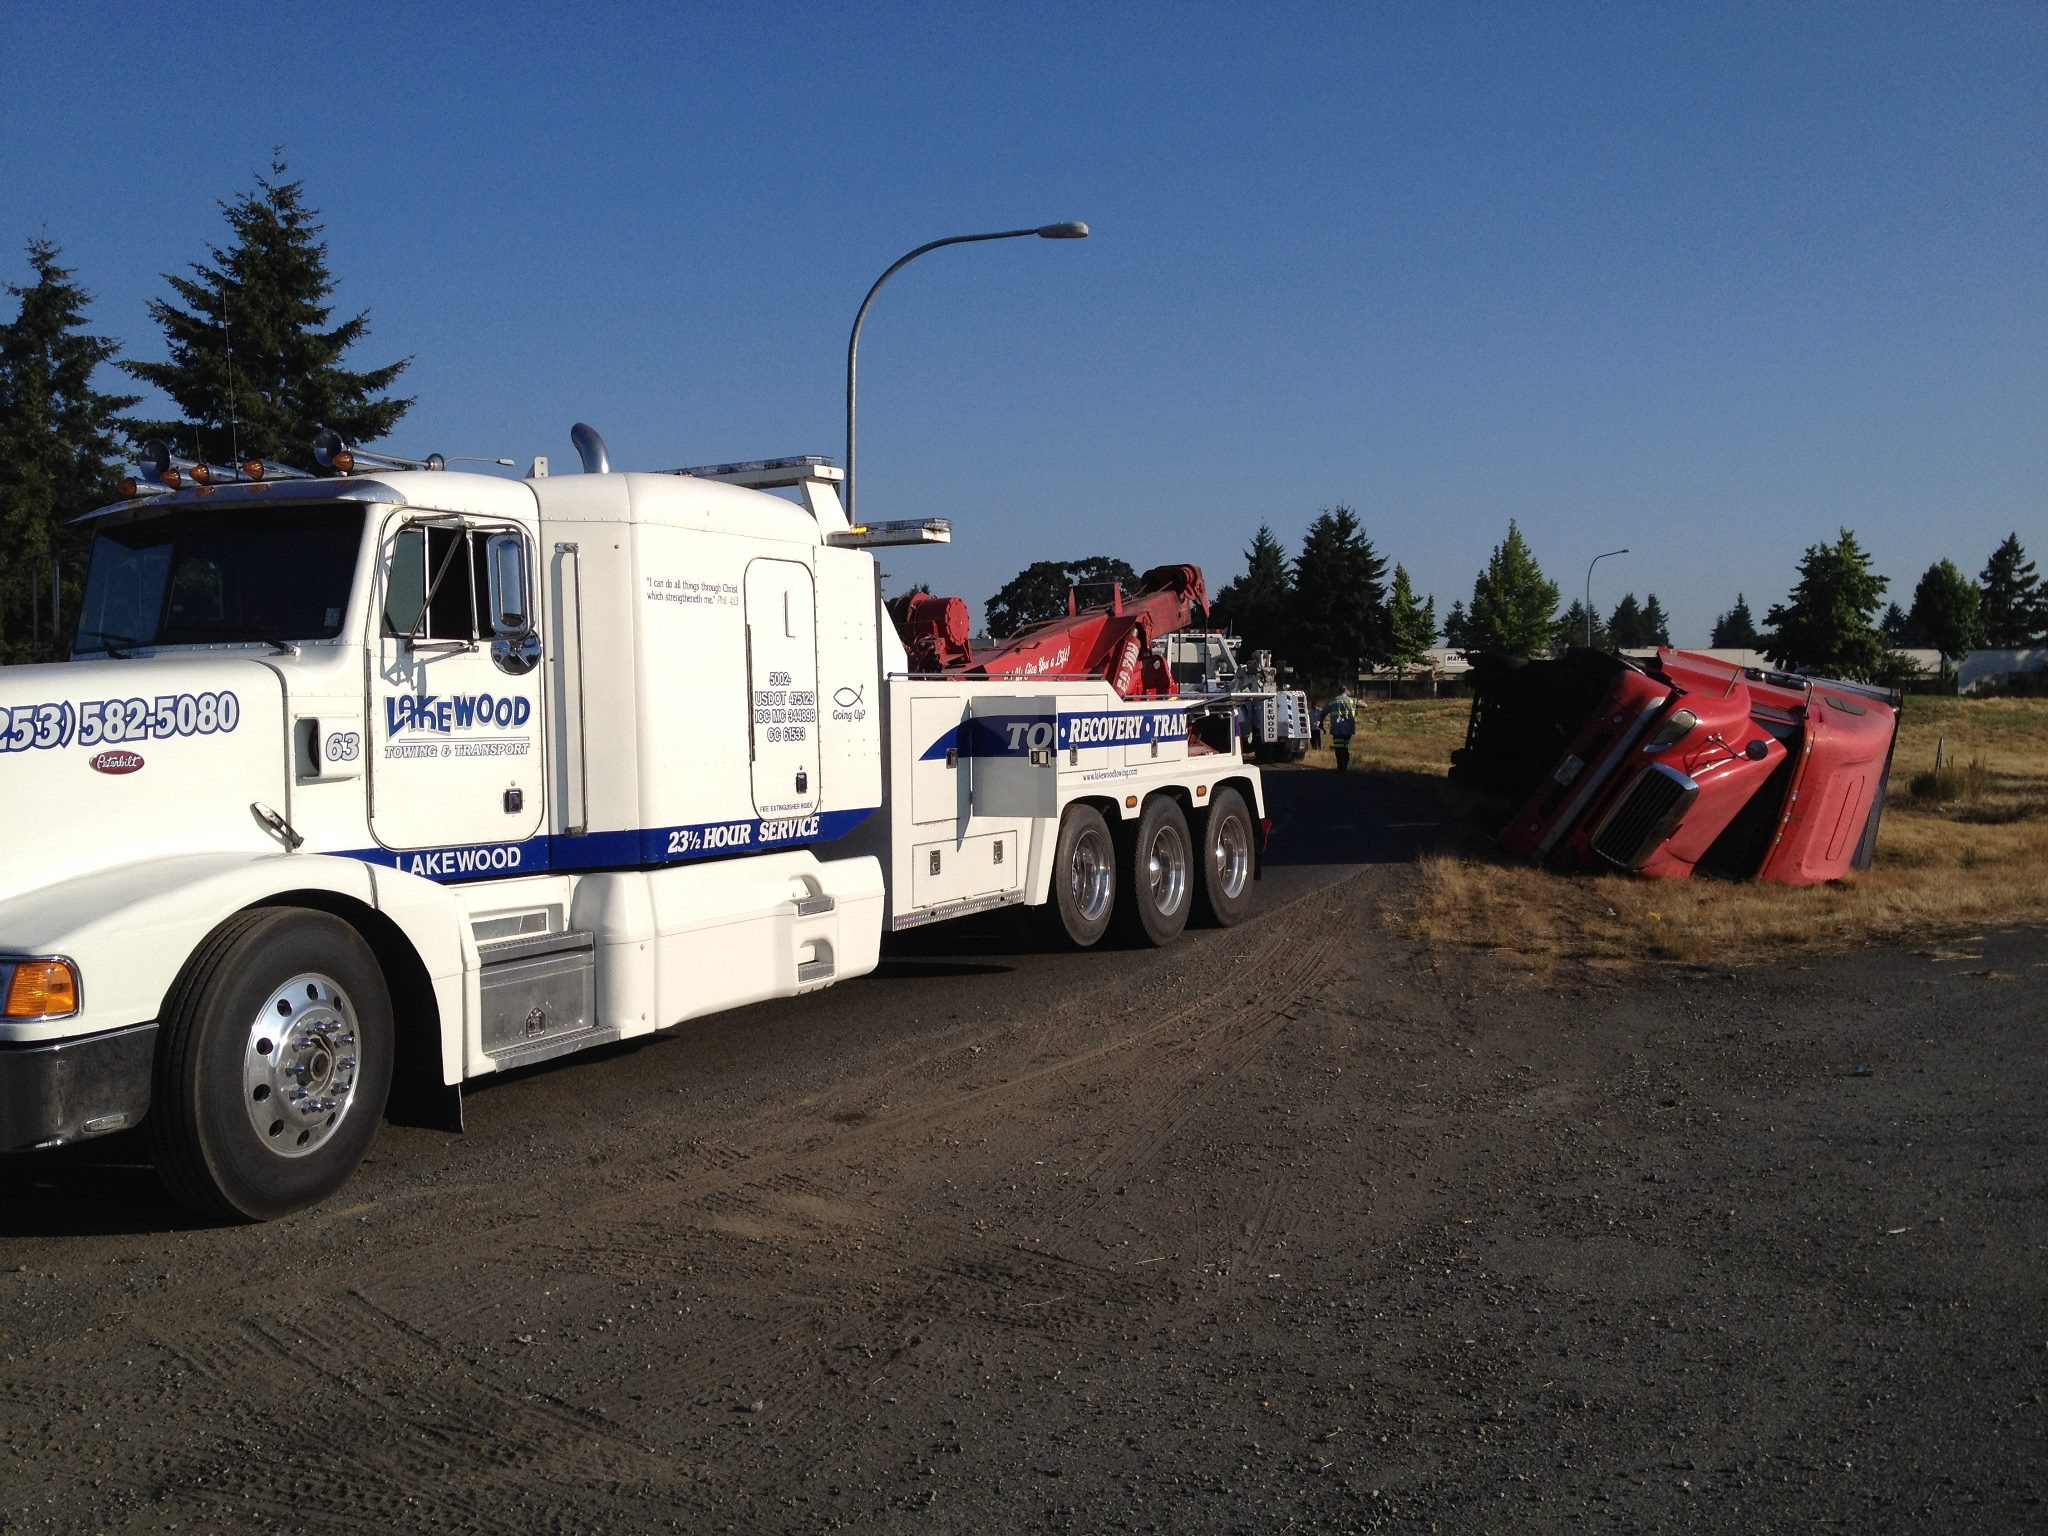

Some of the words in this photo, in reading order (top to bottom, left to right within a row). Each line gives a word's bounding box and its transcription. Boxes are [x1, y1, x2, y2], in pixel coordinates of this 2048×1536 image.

[654, 580, 664, 588] can
[665, 579, 672, 589] do
[682, 580, 700, 593] things
[701, 581, 721, 594] through
[722, 583, 738, 594] Christ
[647, 591, 664, 601] which
[665, 593, 702, 604] strengtheneth
[755, 691, 787, 706] USDOT
[789, 691, 815, 706] 475129
[384, 692, 532, 741] LAKEWOOD
[755, 709, 771, 724] ICC
[772, 709, 786, 724] MC
[832, 709, 853, 723] Going
[854, 709, 866, 722] Up?
[1267, 697, 1275, 739] AKEWOOD
[767, 727, 781, 742] CC
[783, 726, 806, 741] 61533
[1006, 722, 1057, 750] TO
[1069, 715, 1144, 742] RECOVERY
[1153, 713, 1188, 737] TRAN
[325, 733, 360, 761] 63
[385, 745, 437, 759] TOWING
[441, 744, 451, 757] &
[455, 742, 530, 757] TRANSPORT
[97, 754, 141, 769] Peterbilt
[1082, 768, 1138, 781] www.lakewoodtowing.com
[703, 824, 752, 849] HOUR
[758, 816, 820, 842] SERVICE
[395, 846, 521, 876] LAKEWOOD
